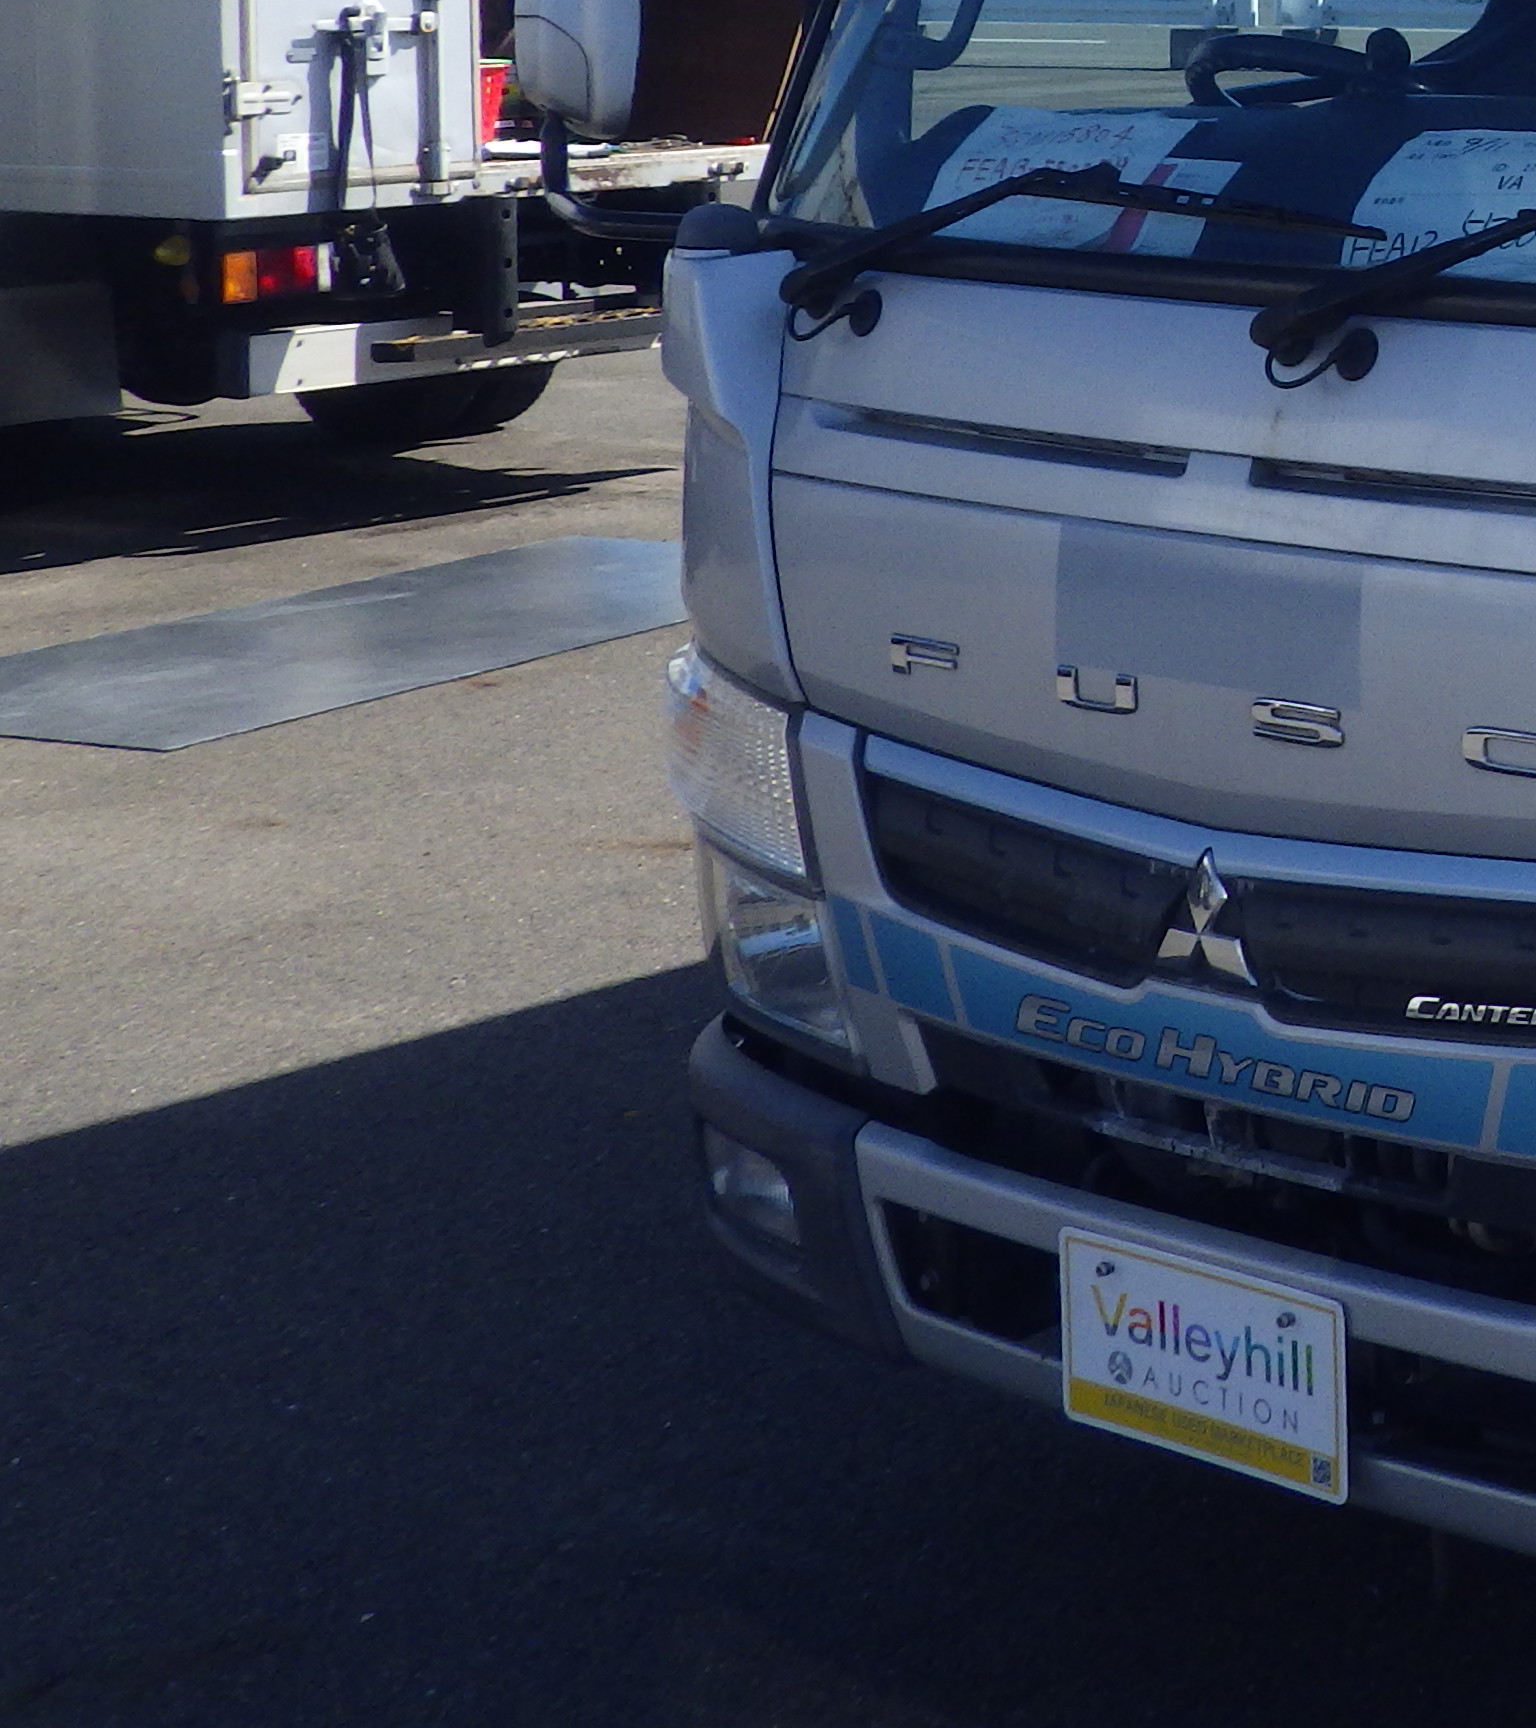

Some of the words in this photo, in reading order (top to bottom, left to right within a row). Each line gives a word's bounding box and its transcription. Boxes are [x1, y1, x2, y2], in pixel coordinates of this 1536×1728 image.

[1497, 174, 1525, 190] VA
[1090, 1283, 1314, 1397] Valleyhill
[1142, 1365, 1300, 1435] AUCTION
